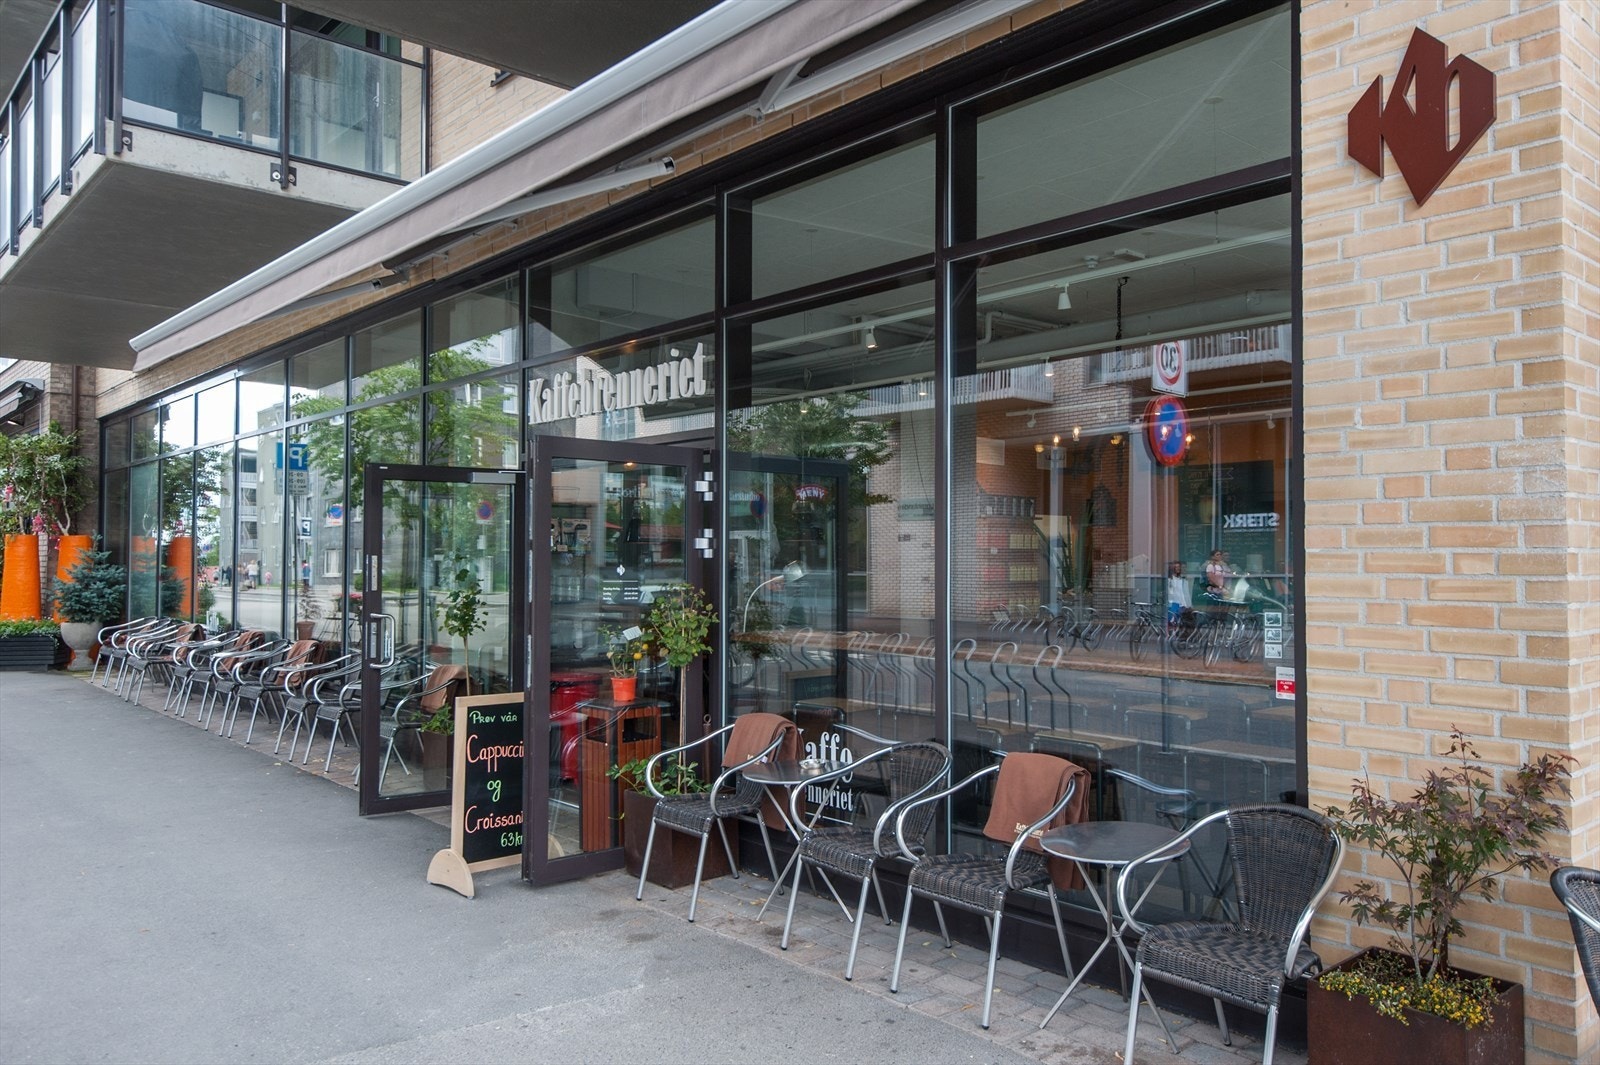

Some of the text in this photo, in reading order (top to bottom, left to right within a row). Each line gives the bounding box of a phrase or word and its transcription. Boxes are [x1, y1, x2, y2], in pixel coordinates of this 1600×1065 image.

[528, 342, 707, 425] Kaffebrenneriet
[798, 728, 854, 783] affe
[486, 780, 502, 802] og
[805, 784, 854, 812] nneriet
